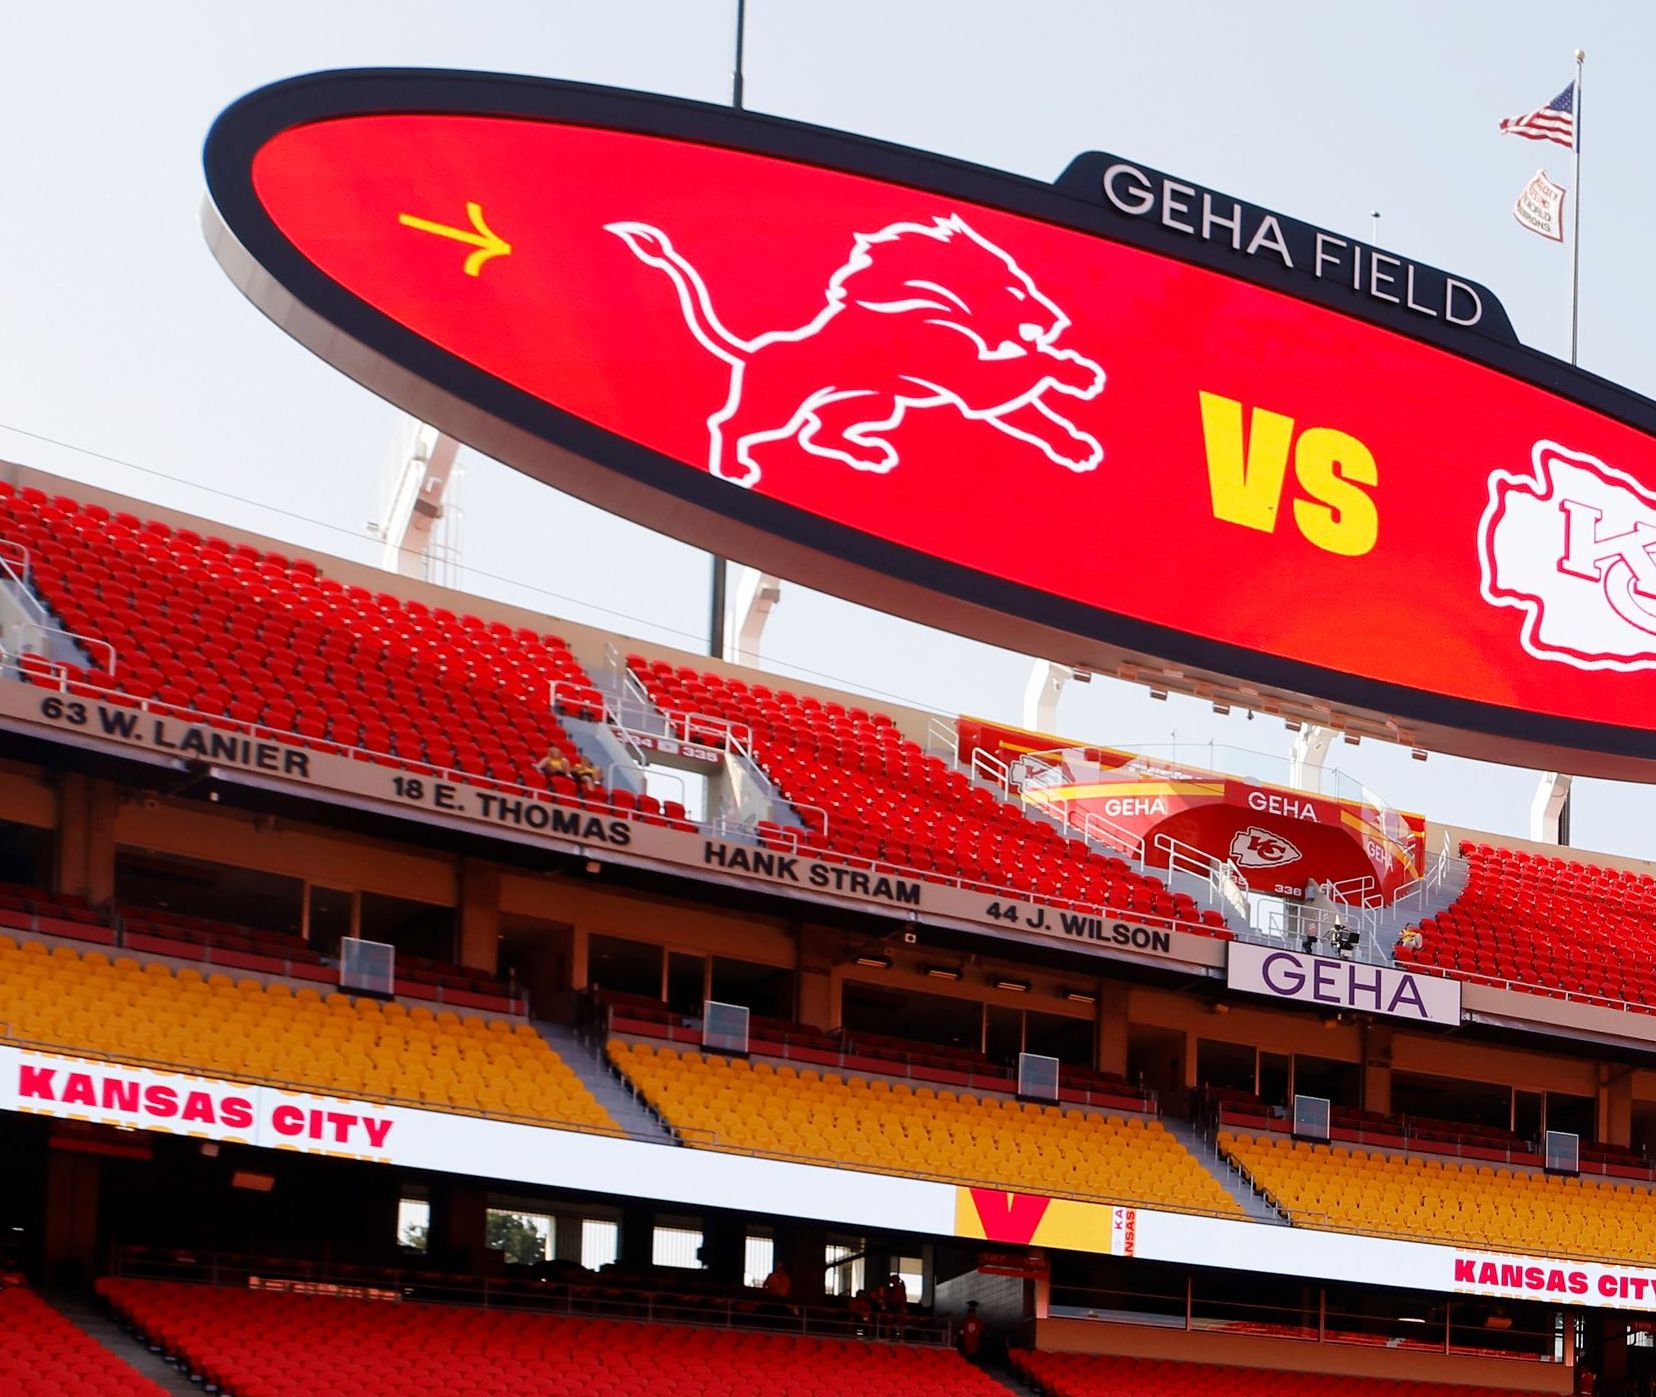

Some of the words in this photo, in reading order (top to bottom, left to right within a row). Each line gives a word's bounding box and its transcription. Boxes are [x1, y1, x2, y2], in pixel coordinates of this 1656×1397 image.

[1103, 164, 1294, 268] GEHA
[1315, 232, 1483, 327] FIELD
[1199, 390, 1378, 557] VS
[41, 697, 87, 725] 63
[98, 706, 142, 741] W.
[154, 721, 310, 778] LANIER
[682, 747, 718, 762] 335
[391, 776, 423, 800] 18
[434, 785, 465, 811] E.
[476, 792, 631, 846] THOMAS
[1105, 797, 1167, 817] GEHA
[1248, 791, 1318, 821] GEHA
[704, 841, 799, 882] HANK
[808, 863, 922, 905] STRAM
[1368, 841, 1394, 870] GEHA
[1275, 884, 1302, 896] 336
[985, 902, 1019, 922] 44
[1025, 909, 1052, 931] J.
[1063, 913, 1172, 953] WILSON
[1262, 952, 1429, 1018] GEHA
[18, 1064, 253, 1129] KANSAS
[271, 1104, 393, 1149] CITY
[1454, 1258, 1589, 1295] KANSAS
